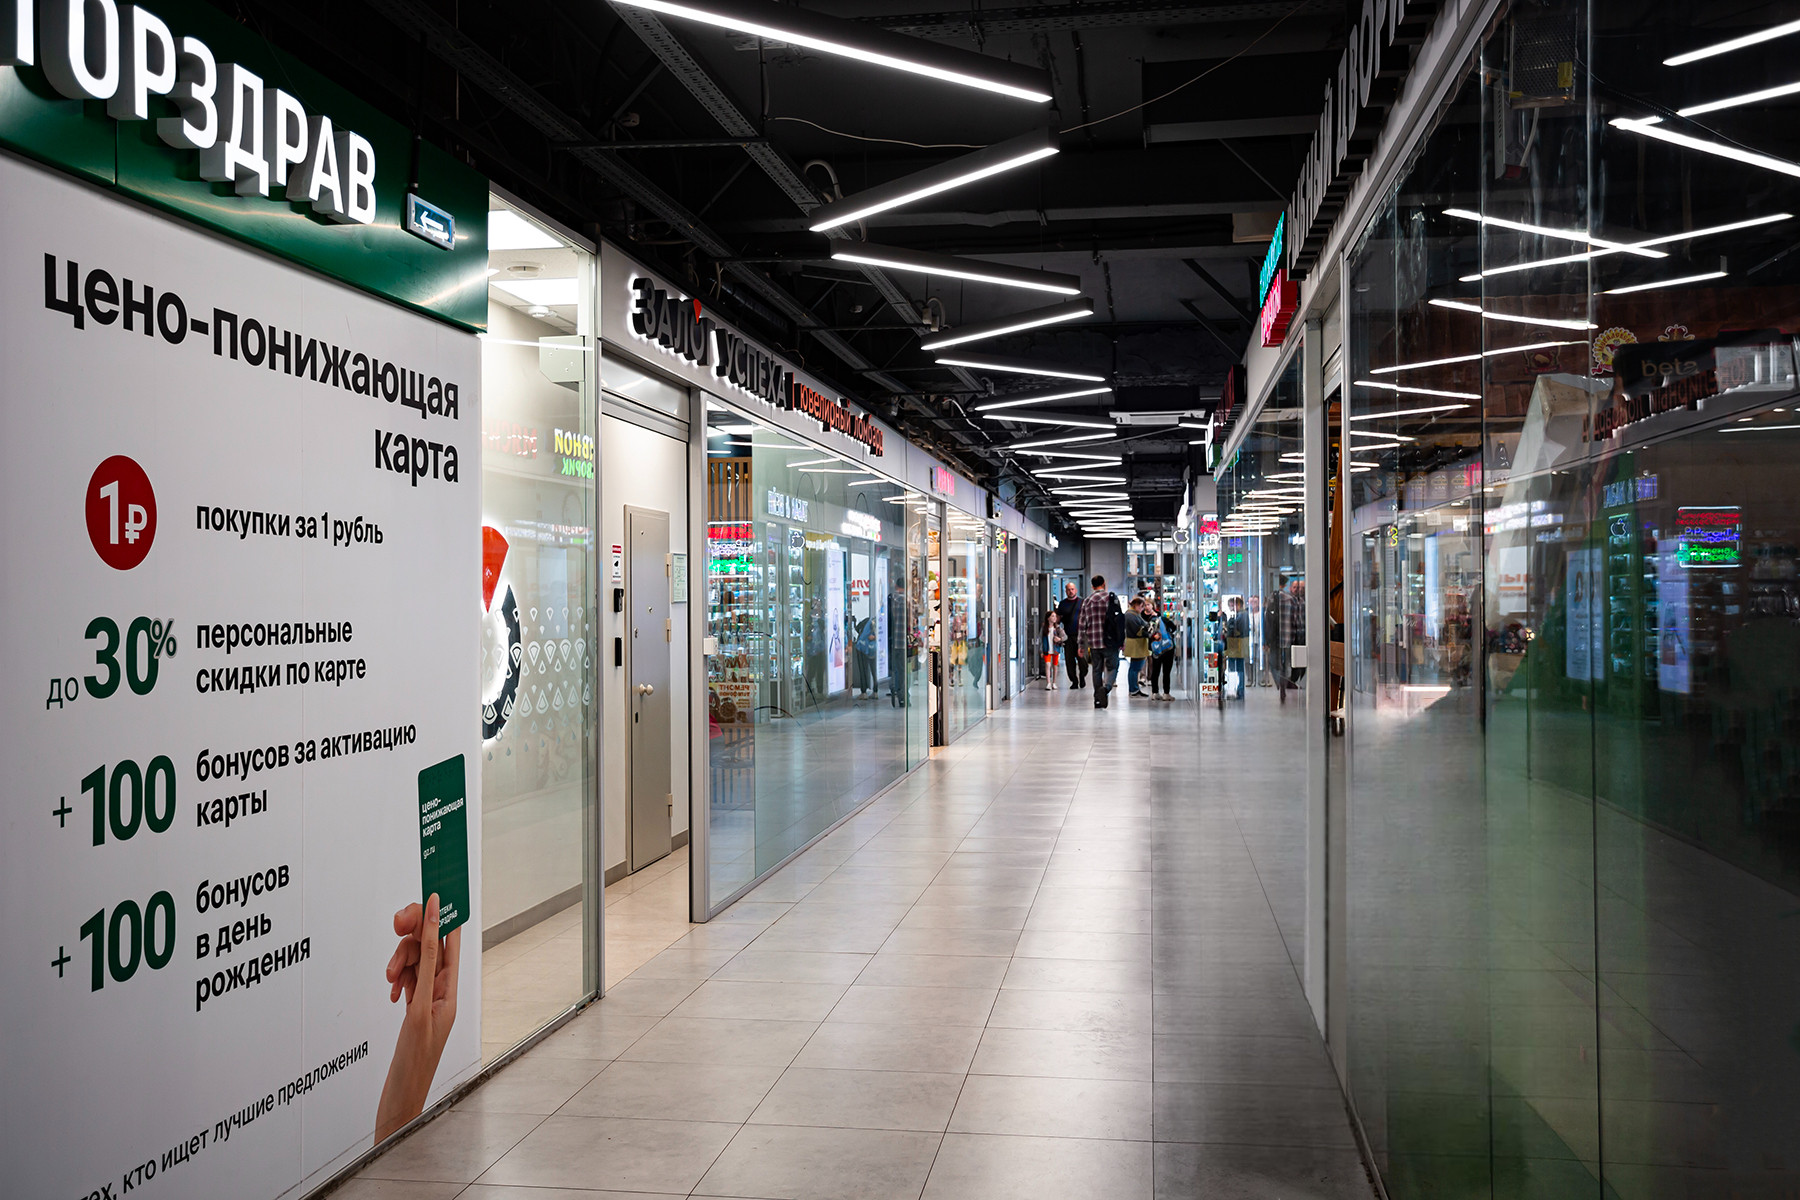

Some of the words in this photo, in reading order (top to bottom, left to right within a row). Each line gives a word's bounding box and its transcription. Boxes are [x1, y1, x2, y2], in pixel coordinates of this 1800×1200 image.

[44, 253, 459, 420] цено-понижающая
[632, 278, 716, 367] ЗАЛОГ
[716, 329, 787, 408] УСПЕХА
[800, 384, 851, 432] ювелирный
[853, 413, 883, 456] ломбард
[374, 429, 459, 487] карта
[196, 505, 290, 541] покупки
[295, 515, 318, 539] за
[321, 511, 330, 540] 1
[333, 516, 384, 547] рубль
[196, 620, 353, 655] персональные
[46, 677, 79, 710] до
[83, 616, 178, 699] 30%
[196, 664, 281, 694] скидки
[286, 661, 310, 686] по
[314, 655, 367, 687] карте
[196, 744, 290, 782] бонусов
[294, 739, 317, 764] за
[320, 723, 417, 760] активацию
[196, 789, 268, 827] карты
[422, 798, 441, 813] цено-
[423, 821, 441, 837] карта
[196, 864, 290, 914] бонусов
[196, 932, 210, 960] в
[215, 912, 272, 953] день
[196, 936, 311, 1013] рождения
[123, 1159, 157, 1195] кто
[161, 1130, 209, 1173] ищет
[213, 1092, 275, 1147] лучшие
[277, 1040, 369, 1106] предложения
